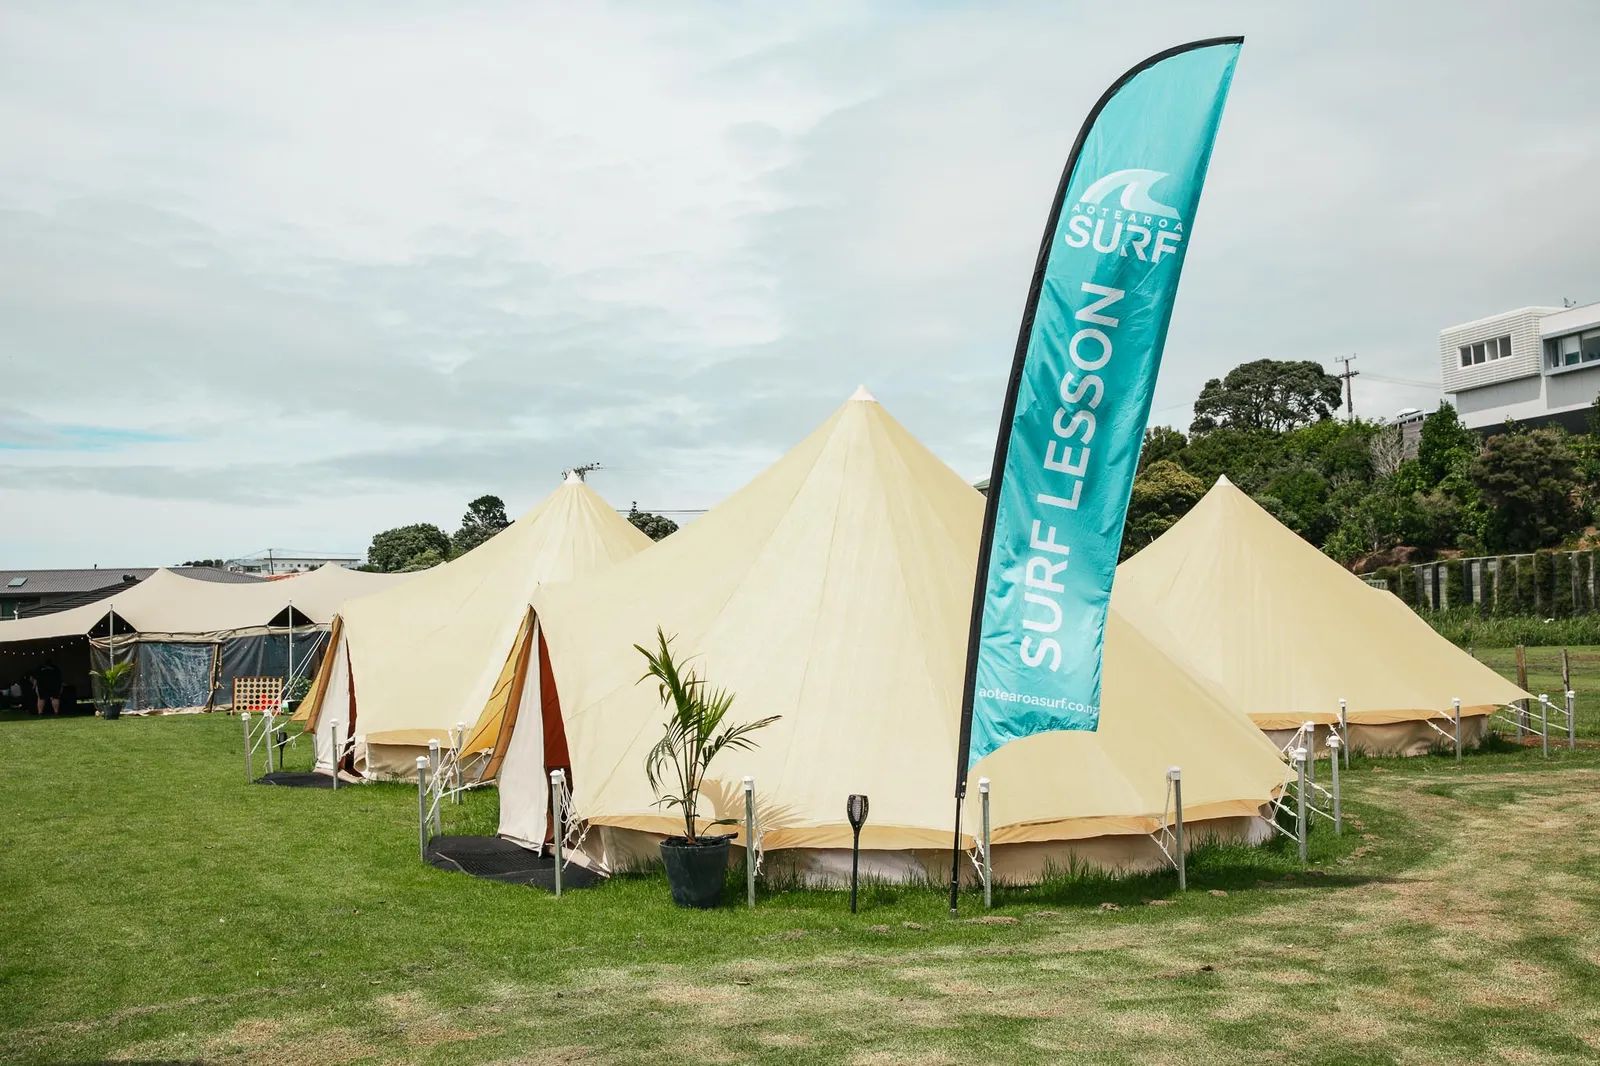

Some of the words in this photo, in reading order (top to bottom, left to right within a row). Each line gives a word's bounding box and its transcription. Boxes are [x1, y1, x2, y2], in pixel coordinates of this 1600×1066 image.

[1065, 215, 1182, 263] SURF
[1072, 204, 1184, 232] AOTEAROA
[1037, 282, 1125, 510] LESSON
[1020, 519, 1070, 672] SURF
